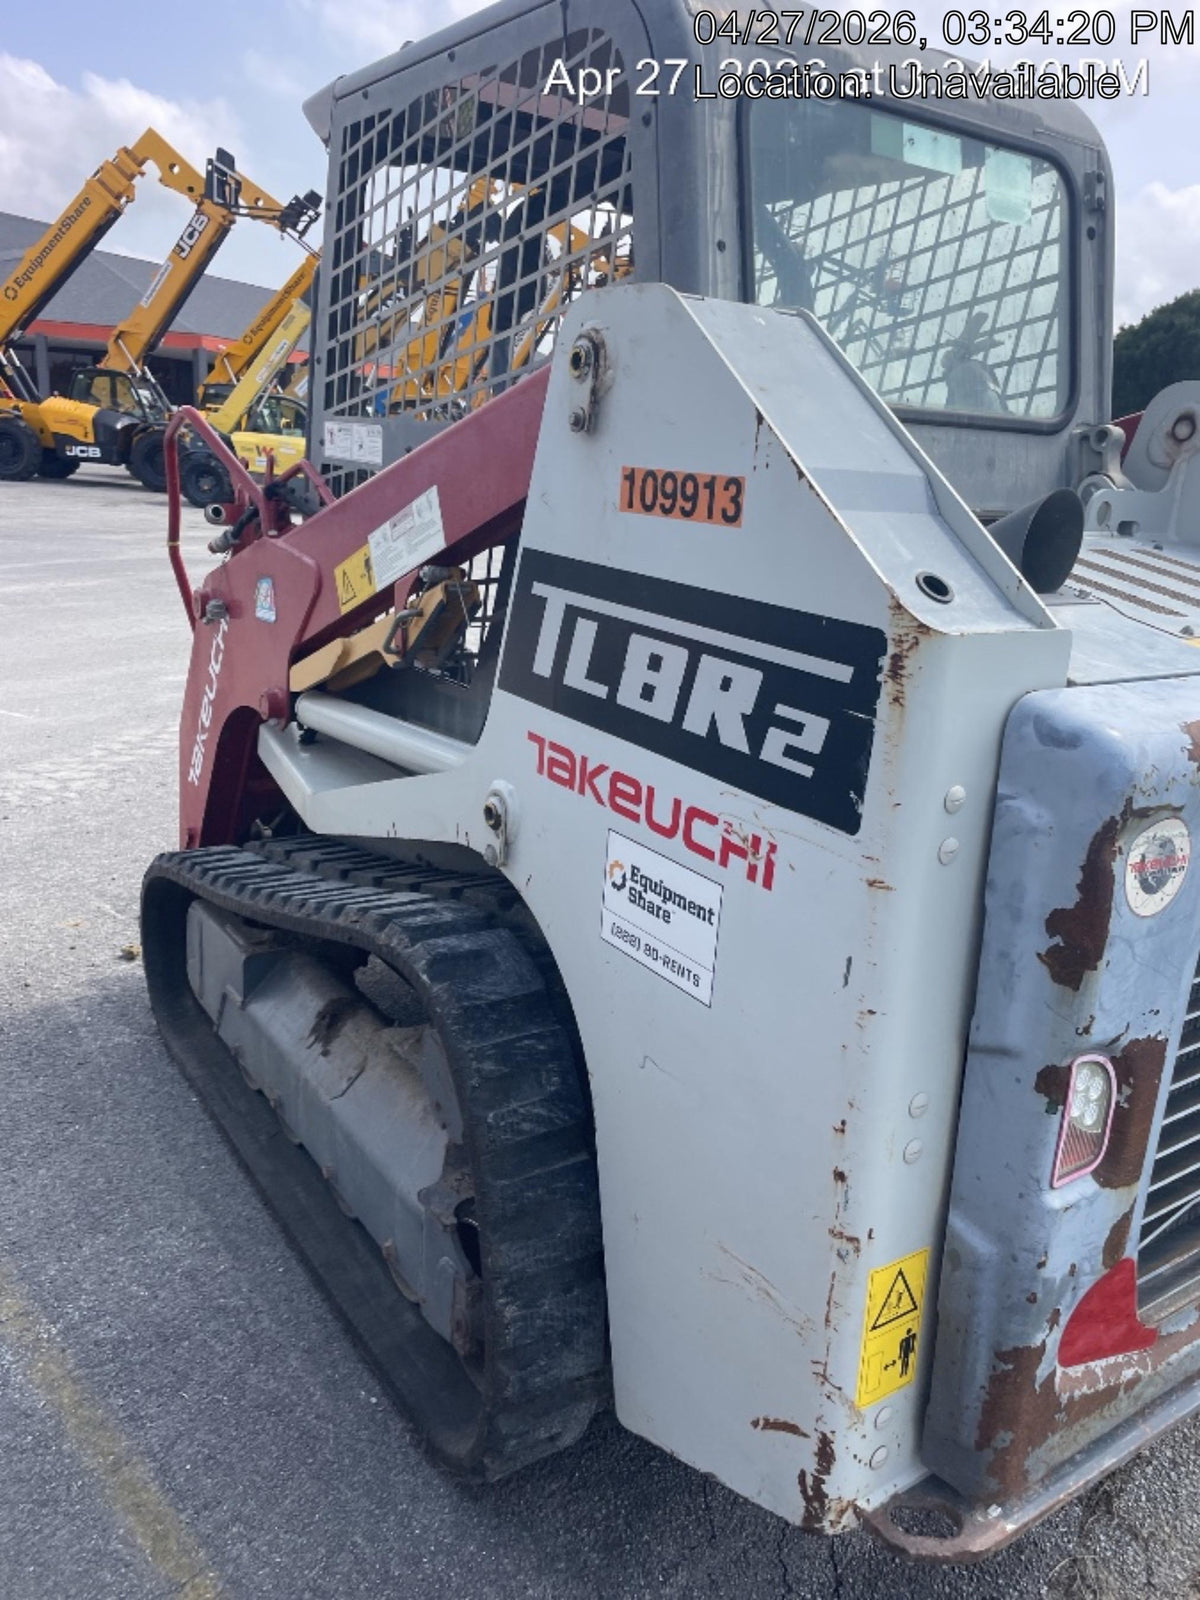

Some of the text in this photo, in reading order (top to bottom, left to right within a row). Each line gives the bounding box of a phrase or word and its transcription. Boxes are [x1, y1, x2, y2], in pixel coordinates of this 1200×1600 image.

[13, 196, 92, 288] EquipmentShare
[178, 213, 210, 259] JCB
[66, 444, 102, 458] JCB
[622, 467, 743, 524] 109913
[627, 885, 672, 925] Share
[628, 863, 716, 927] Equipment
